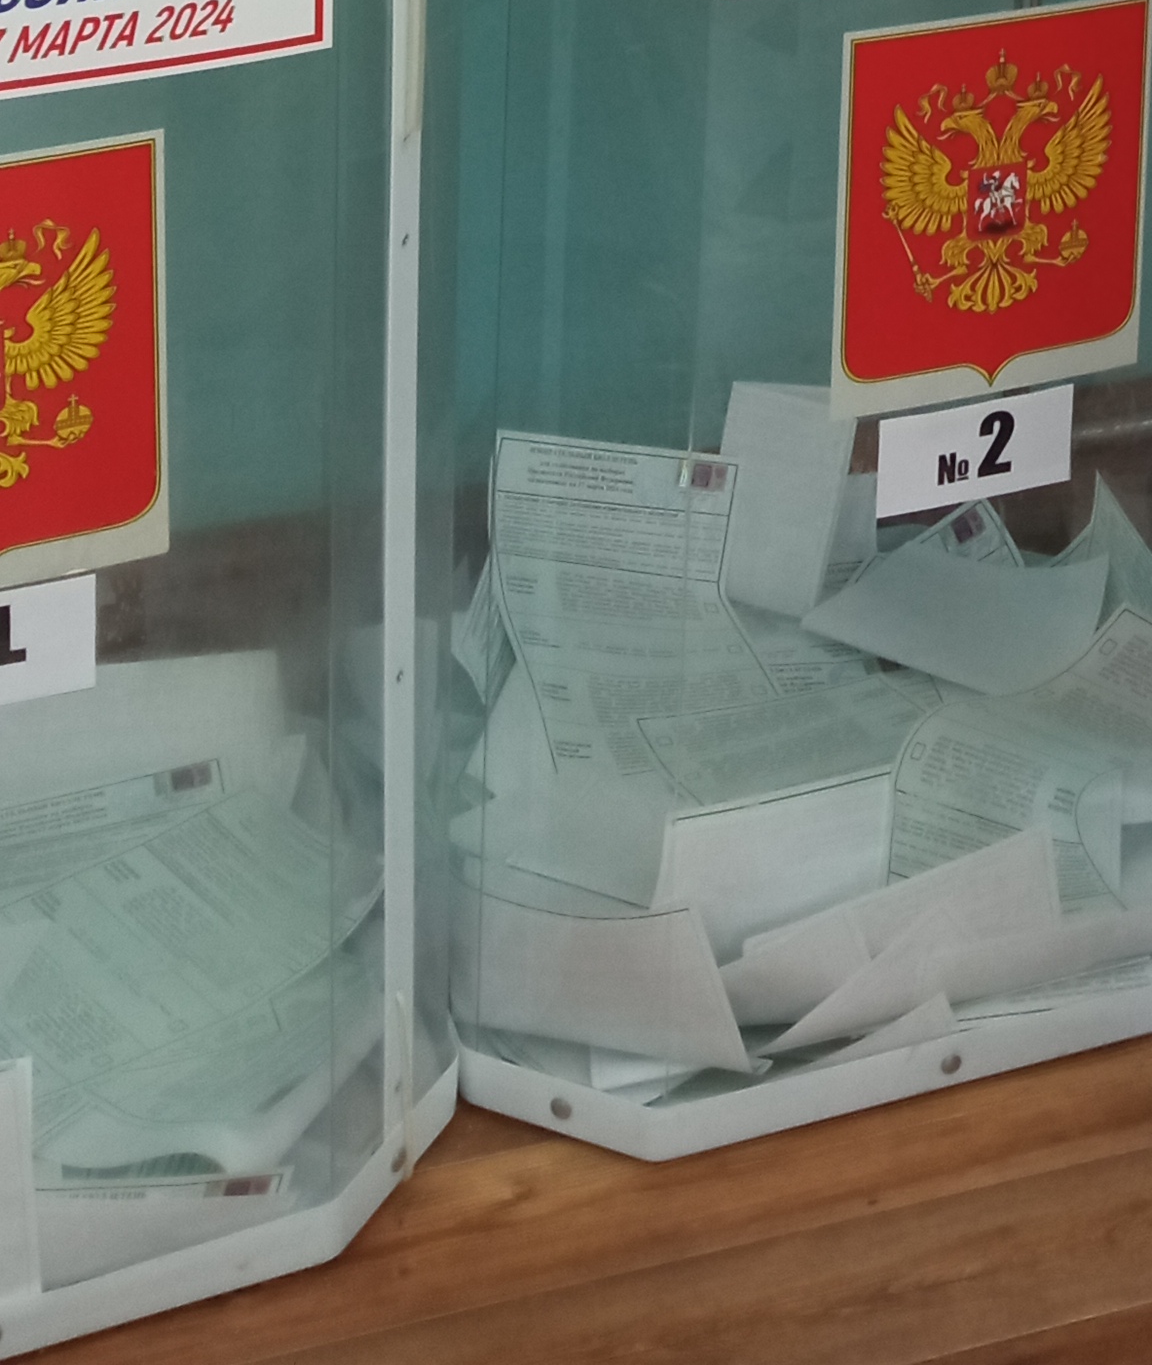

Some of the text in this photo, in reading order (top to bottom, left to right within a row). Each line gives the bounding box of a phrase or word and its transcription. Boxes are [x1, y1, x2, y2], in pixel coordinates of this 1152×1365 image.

[7, 10, 141, 64] МАРТА
[936, 409, 1016, 487] № 2
